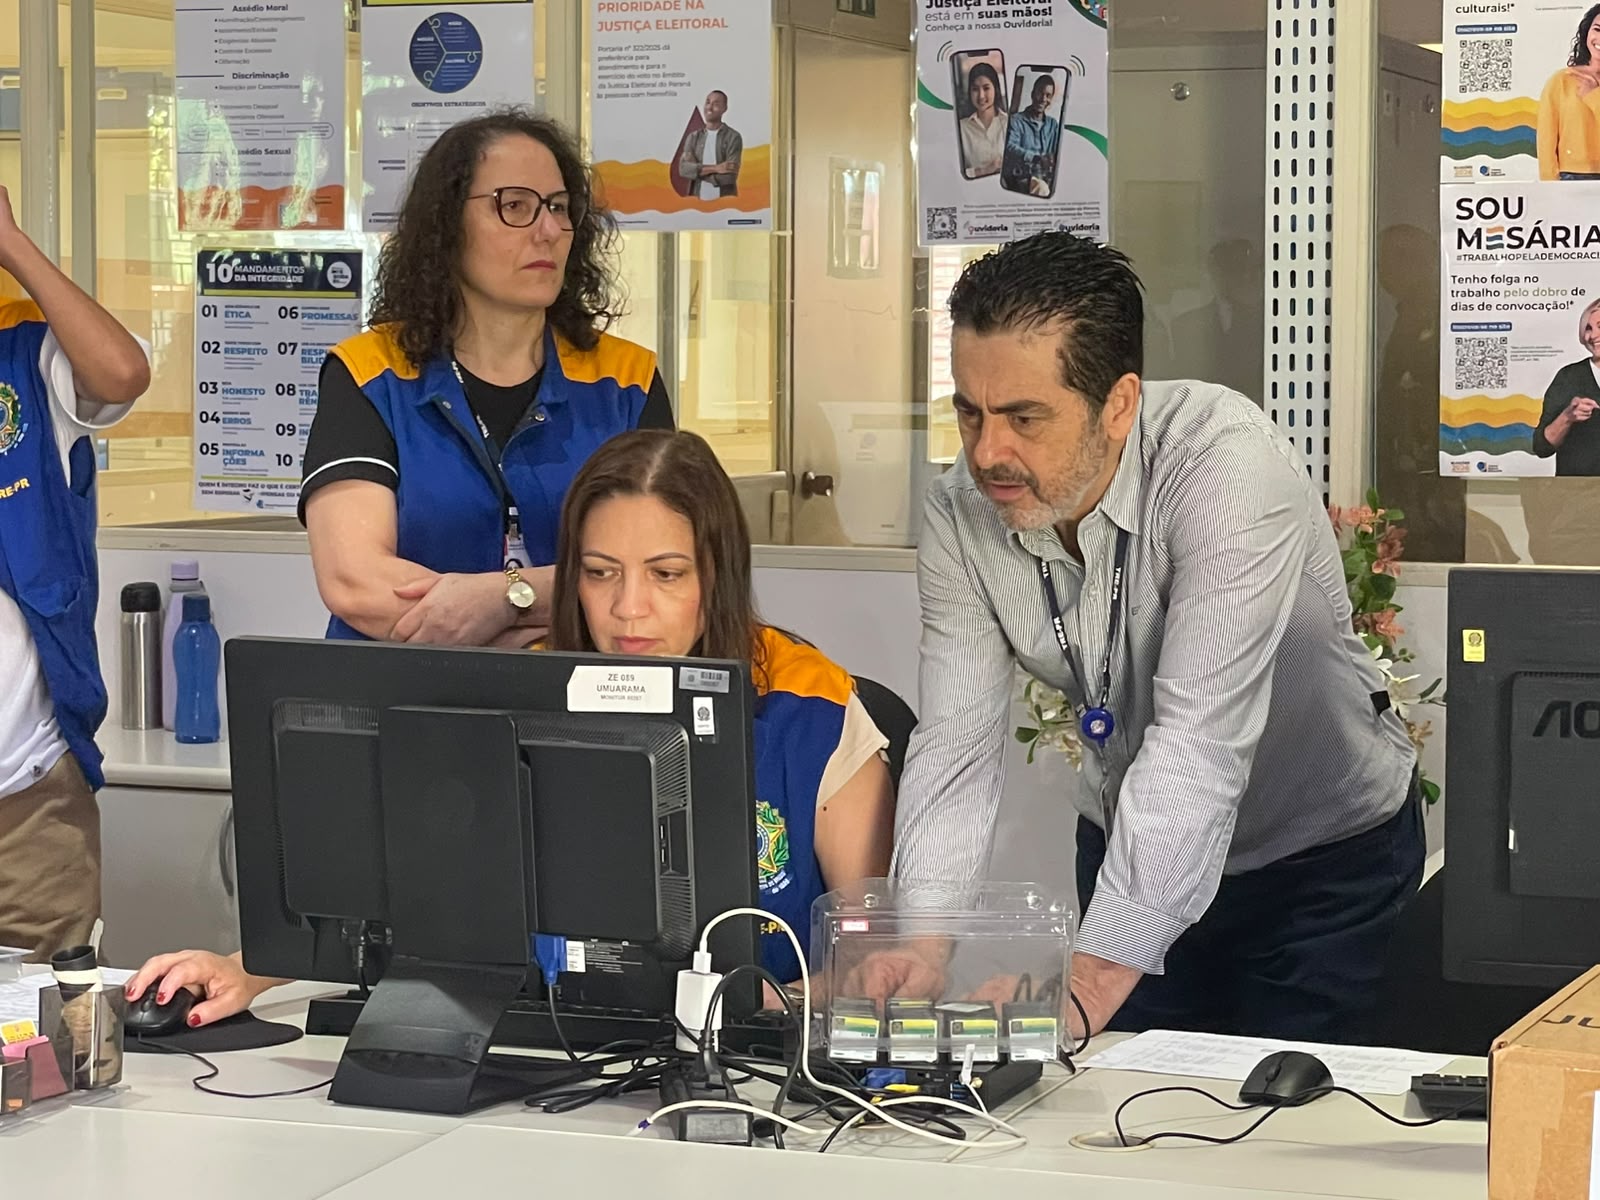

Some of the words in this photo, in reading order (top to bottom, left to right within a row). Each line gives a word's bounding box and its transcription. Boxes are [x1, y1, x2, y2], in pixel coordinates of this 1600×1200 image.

[232, 4, 264, 12] Assédio
[598, 0, 681, 12] PRIORIDADE
[685, 0, 704, 10] NA
[925, 10, 950, 21] está
[954, 11, 974, 20] em
[978, 10, 1008, 18] suas
[1012, 6, 1052, 17] mãos!
[597, 20, 652, 33] JUSTIÇA
[656, 18, 728, 30] ELEITORAL
[925, 23, 965, 32] Conheça
[975, 22, 1001, 30] nossa
[1003, 19, 1053, 28] Ouvidoria!
[232, 72, 290, 80] Discriminação
[264, 147, 291, 155] Sexual
[1455, 196, 1524, 220] SOU
[1456, 220, 1600, 250] MESÁRIA
[1456, 252, 1600, 261] #TRABALHOPELADEMOCRACI
[206, 263, 233, 283] 10
[235, 265, 305, 274] MANDAMENTOS
[247, 274, 303, 283] INTEGRIDADE
[1451, 275, 1487, 284] Tenho
[1491, 274, 1520, 285] folga
[1524, 275, 1539, 283] no
[1451, 288, 1500, 297] trabalho
[1503, 288, 1529, 298] pelo
[1532, 287, 1568, 297] dobro
[1571, 287, 1586, 296] de
[202, 304, 217, 318] 01
[278, 306, 298, 319] 06
[1451, 302, 1474, 311] dias
[1477, 302, 1492, 311] de
[301, 312, 358, 320] PROMESSAS
[201, 341, 221, 354] 02
[224, 347, 268, 355] RESPEITO
[277, 342, 298, 355] 07
[199, 381, 218, 394] 03
[222, 388, 266, 396] HONESTO
[275, 383, 296, 396] 08
[199, 411, 220, 423] 04
[276, 424, 296, 436] 09
[199, 443, 219, 456] 05
[222, 449, 265, 457] INFORMA
[223, 456, 247, 466] ÇÕES
[275, 454, 293, 466] 10
[607, 673, 618, 682] ZE
[596, 685, 646, 693] UMUARAMA
